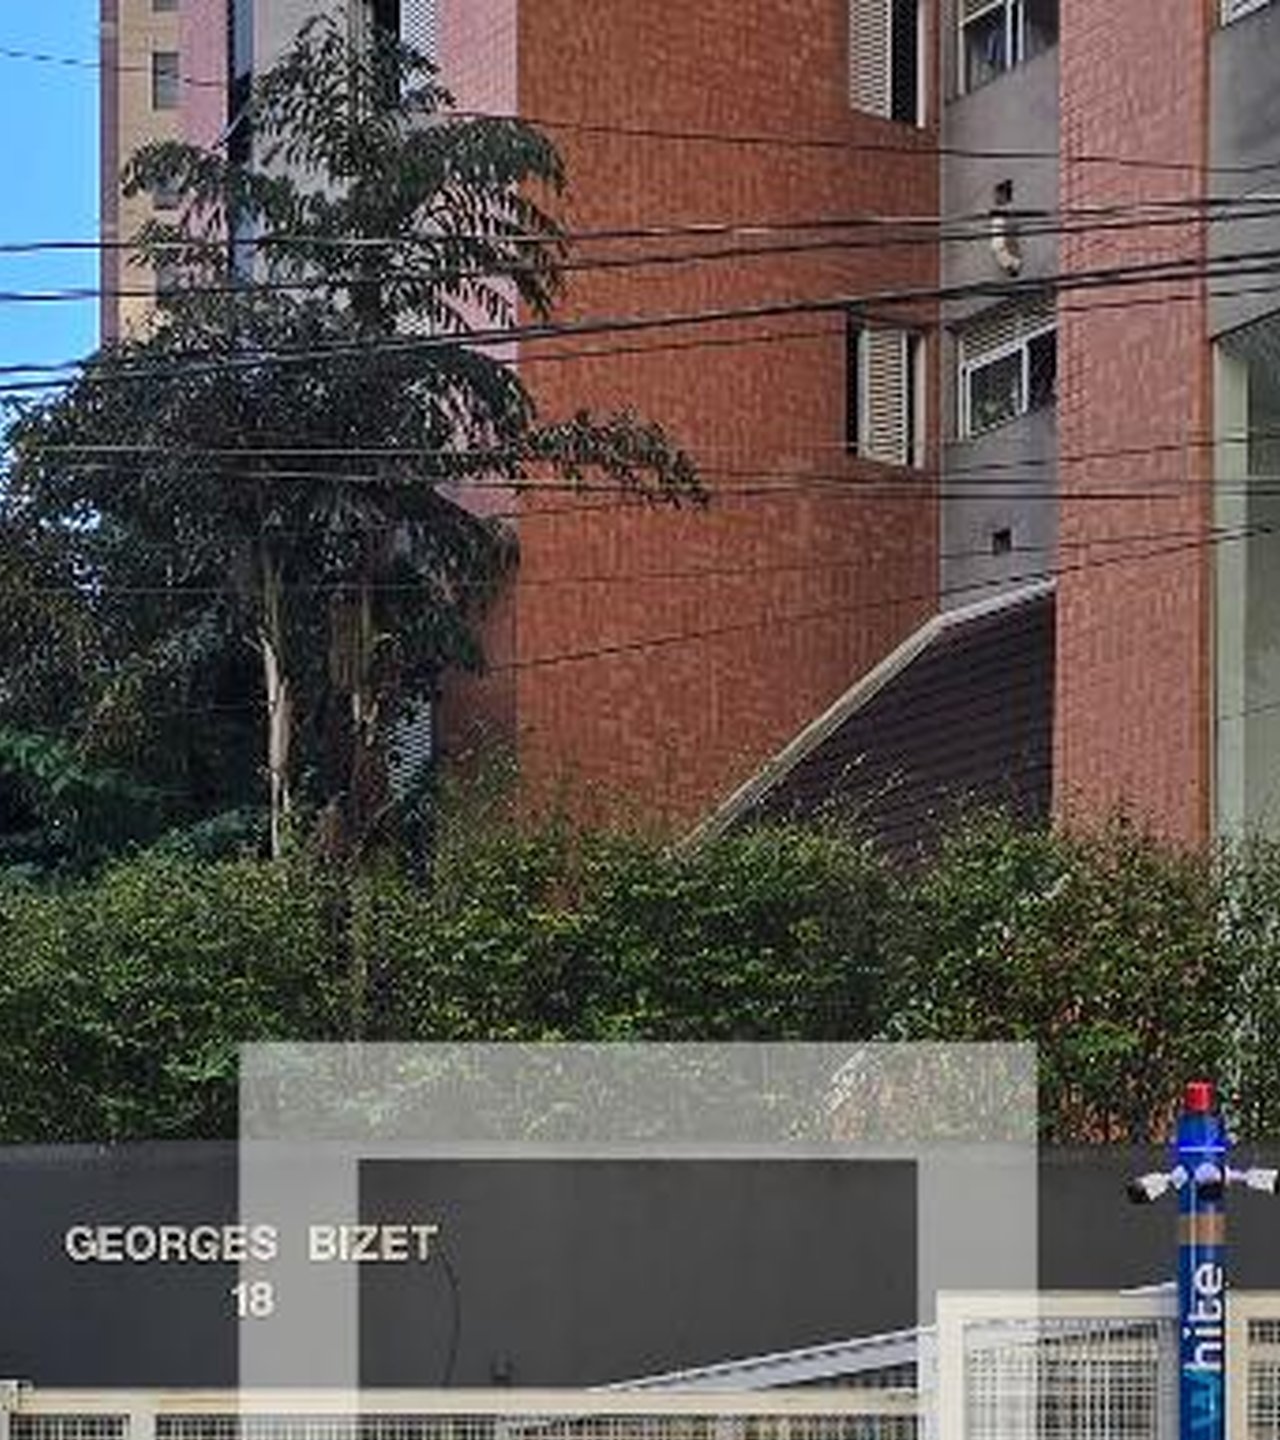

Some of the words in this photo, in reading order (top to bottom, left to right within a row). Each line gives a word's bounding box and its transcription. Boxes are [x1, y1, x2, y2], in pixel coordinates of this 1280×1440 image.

[65, 1225, 278, 1261] GEORGES
[308, 1225, 439, 1261] BIZET
[231, 1282, 275, 1317] 18
